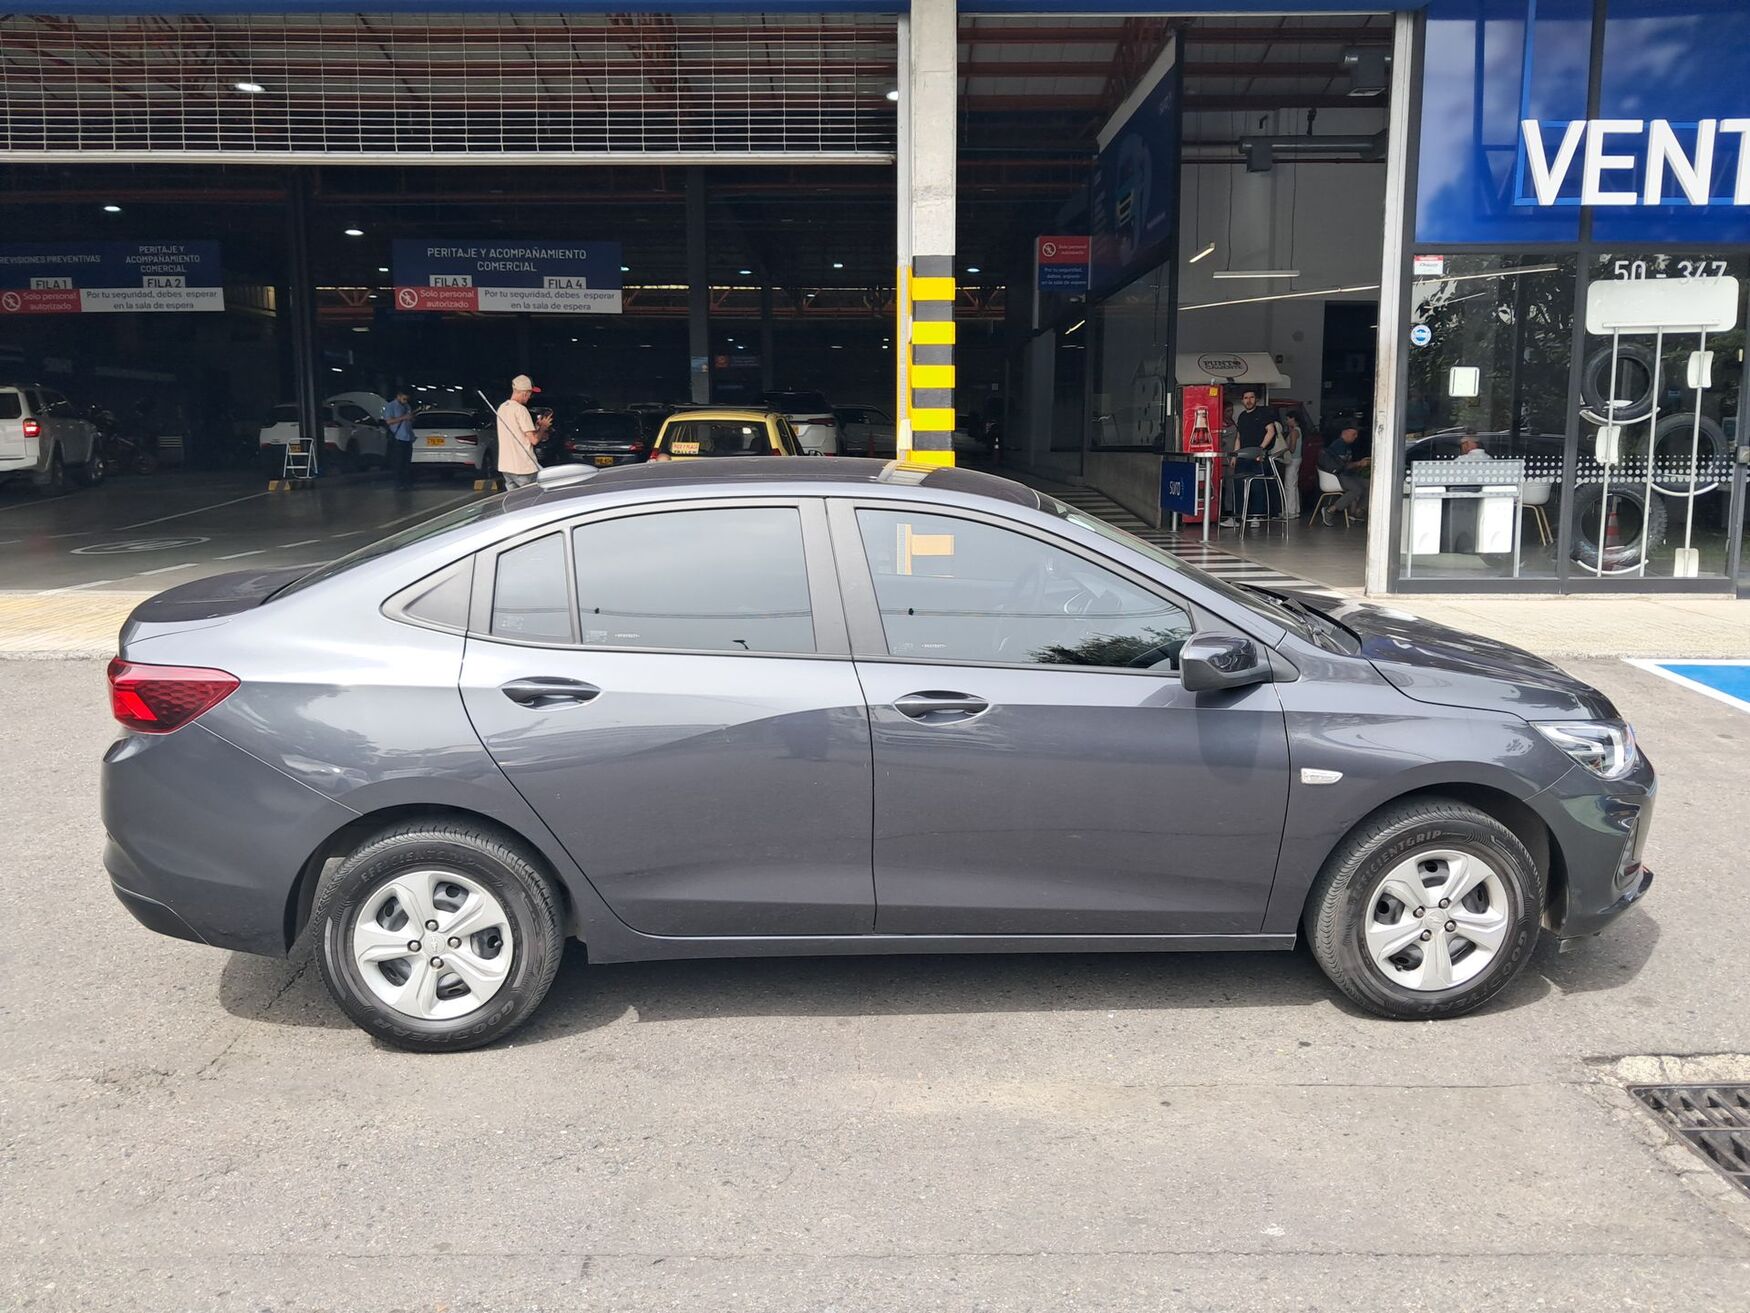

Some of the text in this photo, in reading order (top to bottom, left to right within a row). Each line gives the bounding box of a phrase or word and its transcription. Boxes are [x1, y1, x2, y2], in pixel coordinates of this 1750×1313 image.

[139, 245, 185, 254] PERITAJE Y
[427, 247, 586, 259] PERITAJE Y ACOMPAÑAMIENTO
[477, 261, 537, 271] COMERCIAL
[1614, 261, 1646, 280] 50
[36, 280, 60, 289] FILA
[147, 279, 182, 288] FILA 2
[434, 278, 468, 287] FILA 3
[548, 279, 582, 289] FILA 4
[186, 291, 218, 300] esperar
[420, 290, 474, 300] Solo personal
[485, 290, 498, 298] Por
[500, 290, 508, 298] tu
[509, 291, 553, 301] seguridad,
[583, 293, 615, 301] esperar
[551, 302, 561, 310] de
[563, 304, 591, 312] espera
